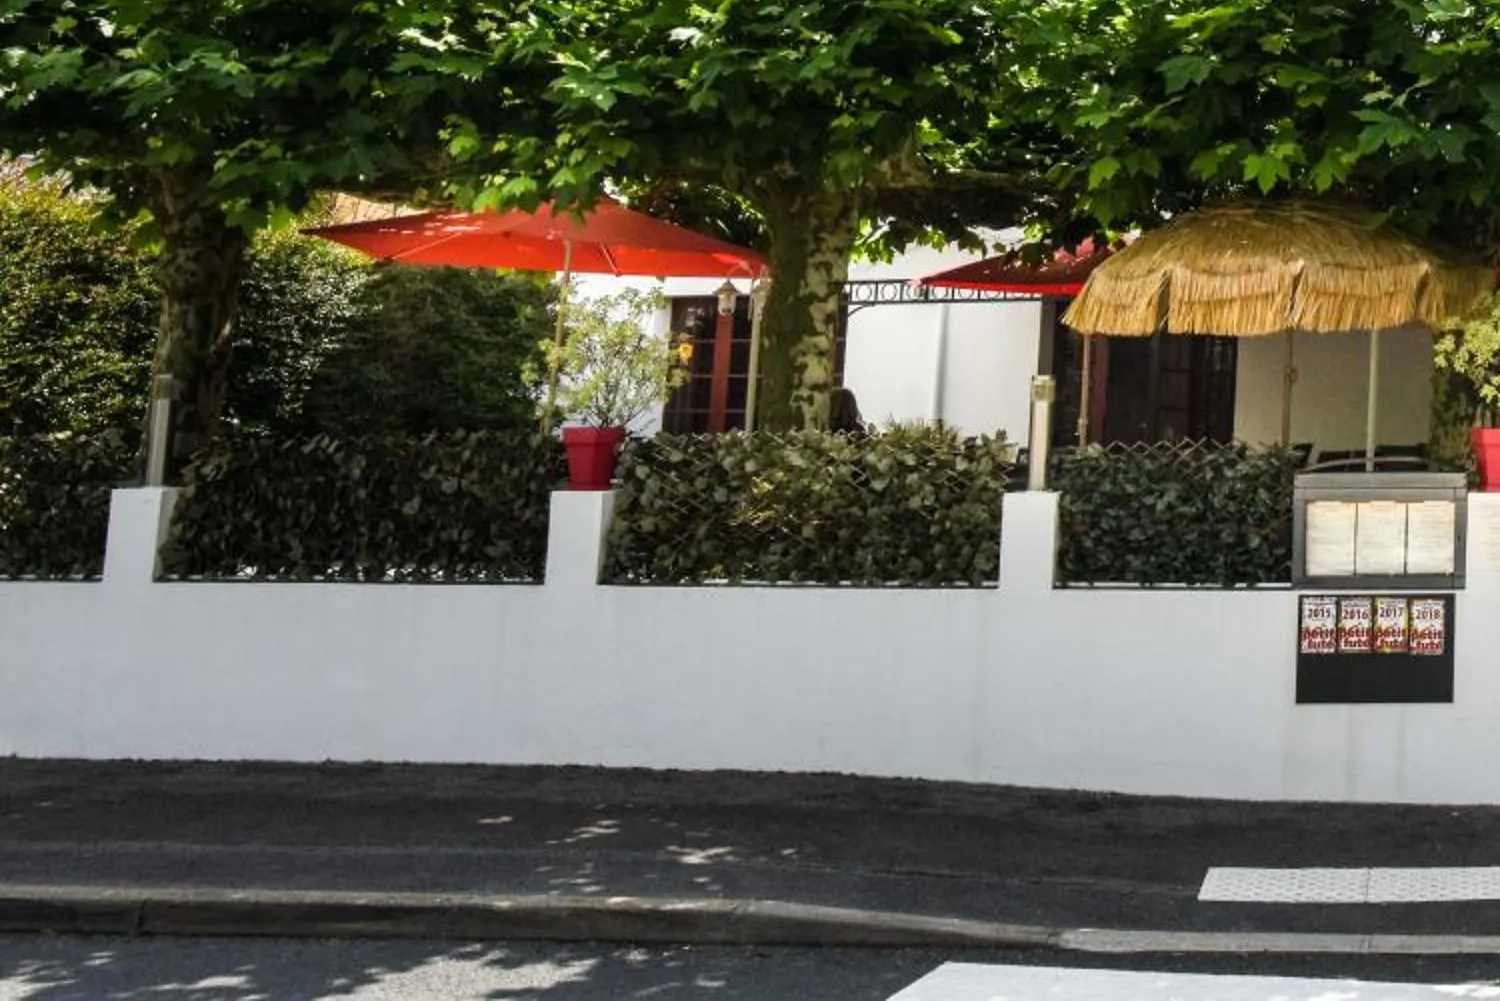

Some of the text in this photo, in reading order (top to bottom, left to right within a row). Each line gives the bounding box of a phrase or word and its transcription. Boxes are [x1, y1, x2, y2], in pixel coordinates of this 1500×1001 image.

[1307, 608, 1331, 618] 2015
[1343, 608, 1368, 619] 2016
[1379, 606, 1404, 618] 2017
[1415, 608, 1441, 620] 2018
